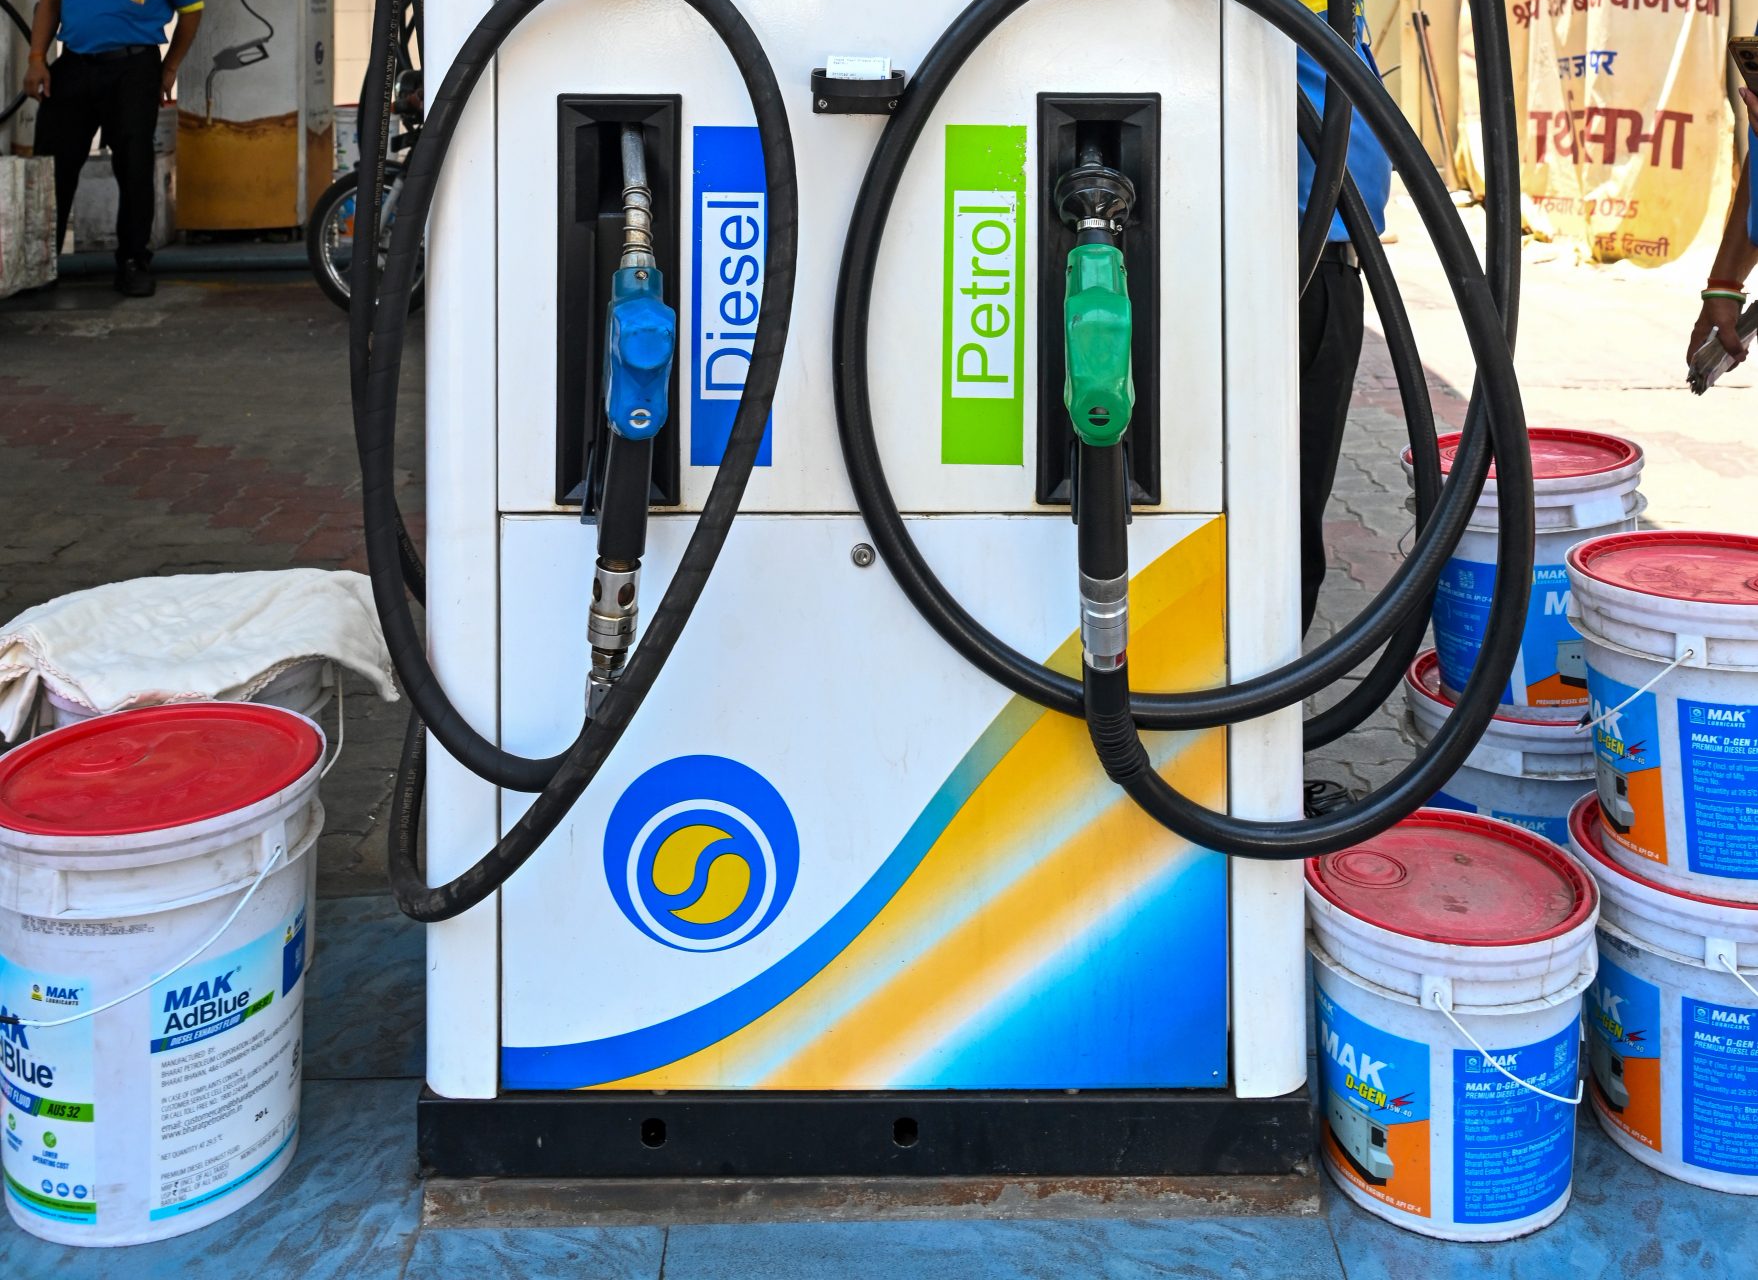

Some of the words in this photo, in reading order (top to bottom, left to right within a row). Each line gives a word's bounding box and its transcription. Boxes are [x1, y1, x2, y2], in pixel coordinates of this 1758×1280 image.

[705, 200, 760, 392] Diesel
[957, 204, 1011, 384] Petrol
[1537, 570, 1568, 580] MAK
[1707, 709, 1746, 723] MAK
[1597, 728, 1625, 756] D-GEN
[1692, 733, 1719, 744] MAK
[1724, 737, 1751, 747] D-GEN
[1692, 742, 1723, 752] PREMIUM
[1724, 746, 1746, 754] DIESEL
[46, 986, 80, 1000] MAK
[163, 970, 235, 1013] MAK
[164, 991, 250, 1034] AdBlue
[1711, 1010, 1751, 1025] MAK
[170, 1033, 194, 1047] DIESEL
[1694, 1031, 1721, 1044] MAK
[1726, 1038, 1754, 1048] D-GEN
[1321, 1019, 1388, 1092] MAK
[1726, 1047, 1749, 1056] DIESEL
[1345, 1072, 1388, 1109] D-GEN
[1465, 1082, 1491, 1092] MAK
[1465, 1091, 1496, 1099] PREMIUM
[1496, 1090, 1516, 1098] DIESEL
[48, 1103, 66, 1118] AUS
[66, 1106, 80, 1118] 32
[1386, 1102, 1413, 1118] 15W-40
